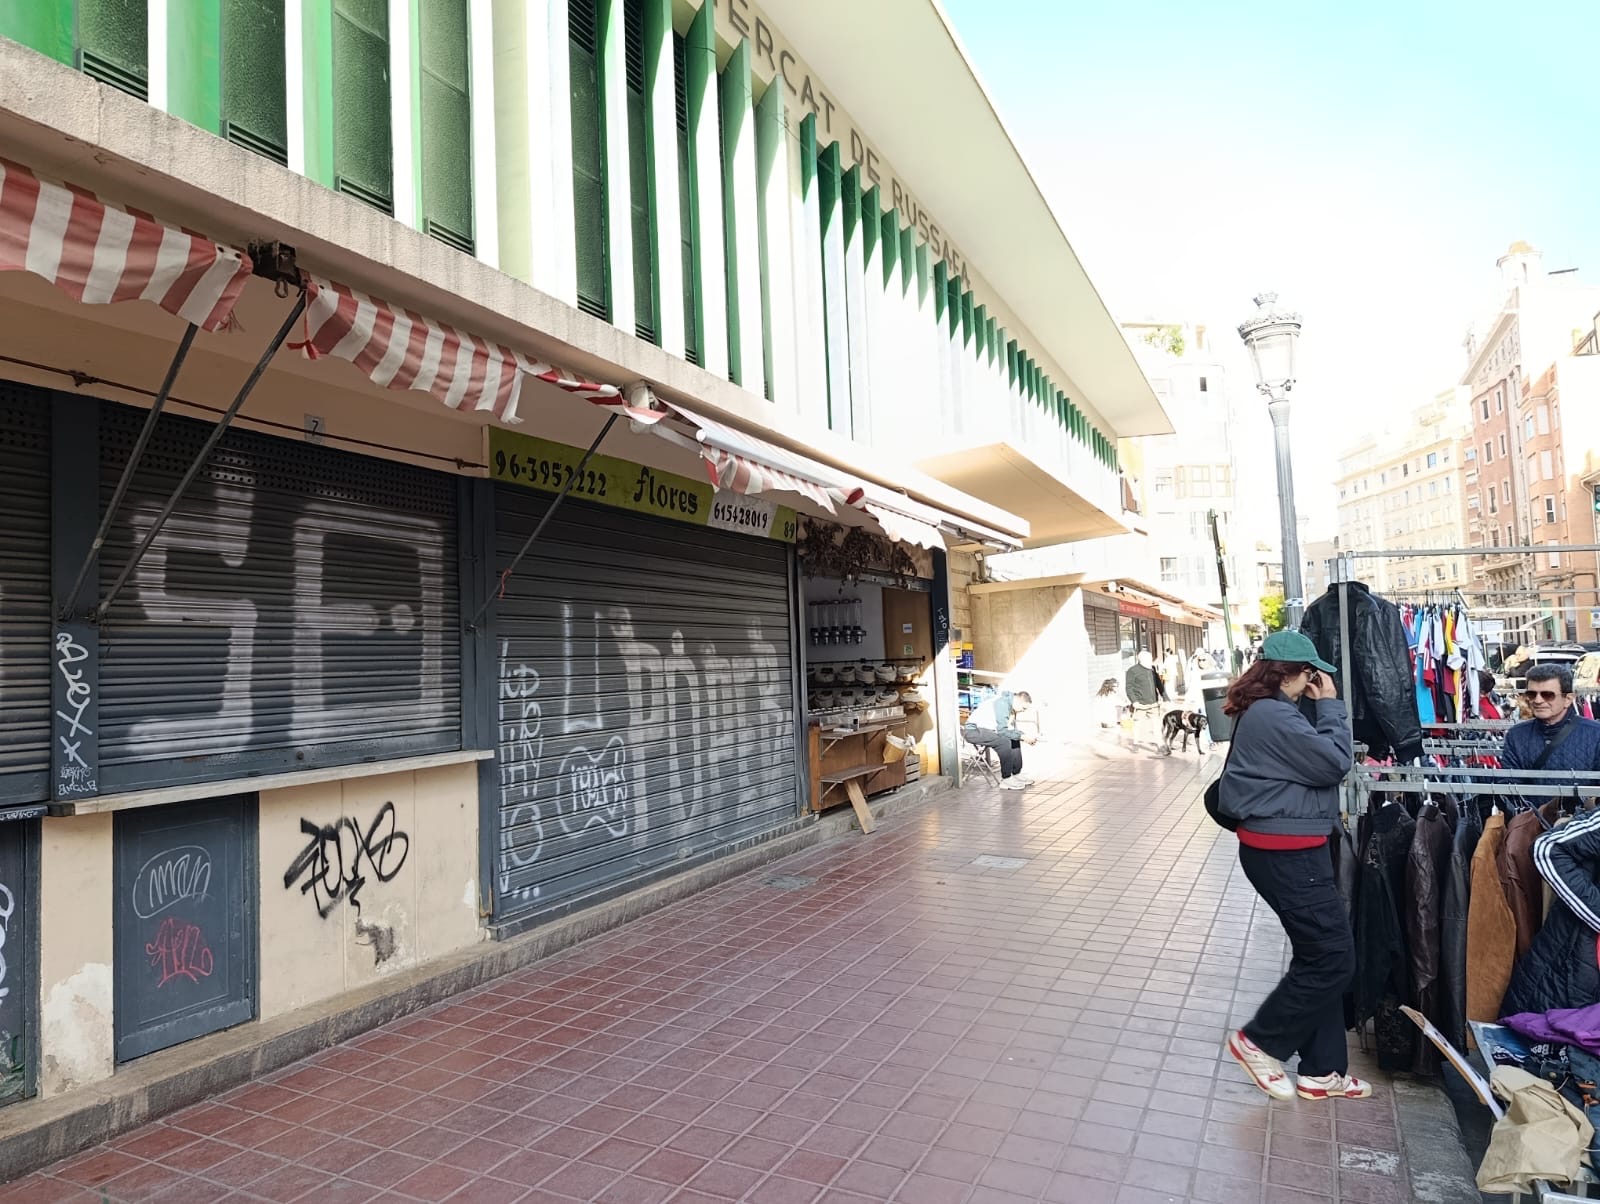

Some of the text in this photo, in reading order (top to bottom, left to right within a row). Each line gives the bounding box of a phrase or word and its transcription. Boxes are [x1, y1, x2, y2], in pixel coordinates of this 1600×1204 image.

[714, 0, 971, 289] ERCAT DE RUSSAFA
[311, 419, 319, 437] 7
[714, 502, 768, 529] 615428019
[783, 520, 796, 539] 89
